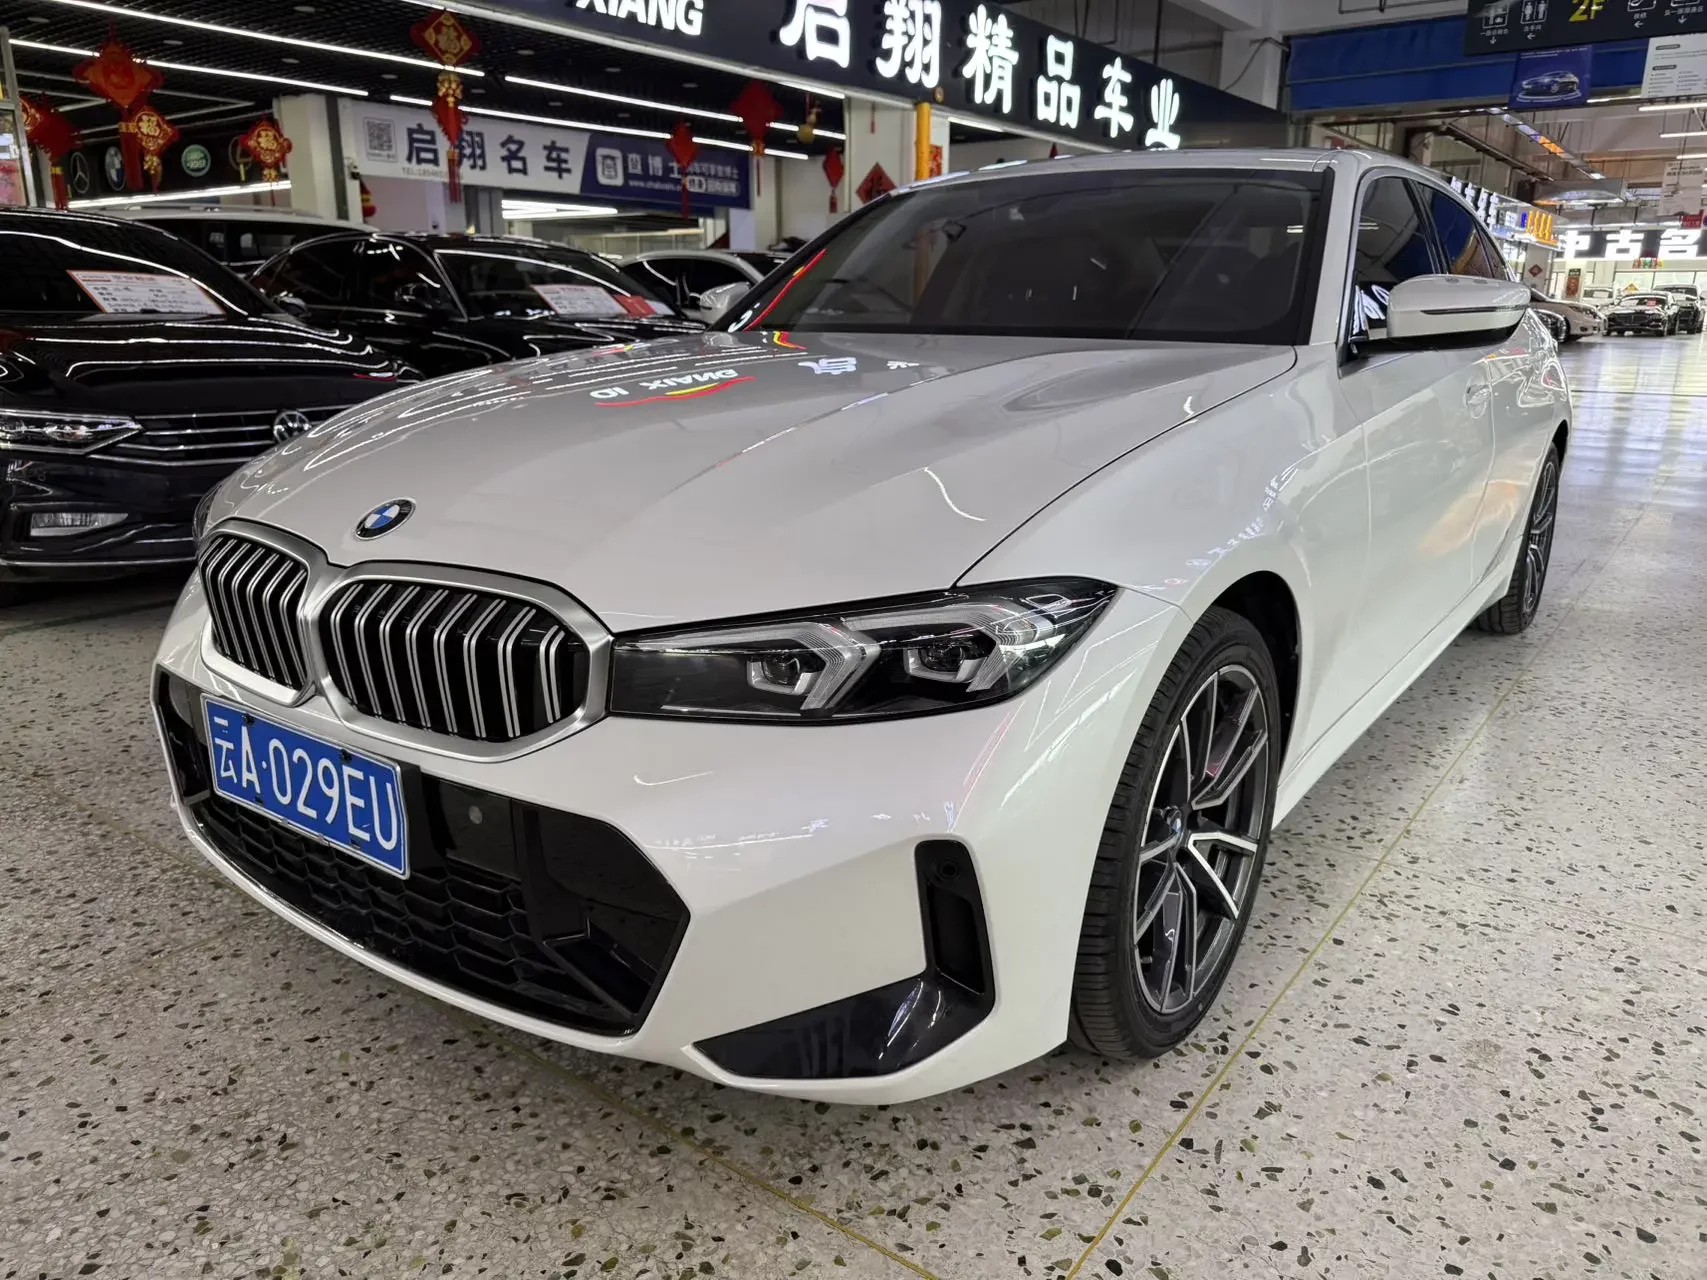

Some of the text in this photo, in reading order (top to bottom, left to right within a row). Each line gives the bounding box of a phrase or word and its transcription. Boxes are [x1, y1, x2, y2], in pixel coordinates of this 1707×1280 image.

[575, 0, 704, 36] ANG
[778, 0, 1182, 150] 启翔精品车业
[406, 122, 572, 180] 启翔名车
